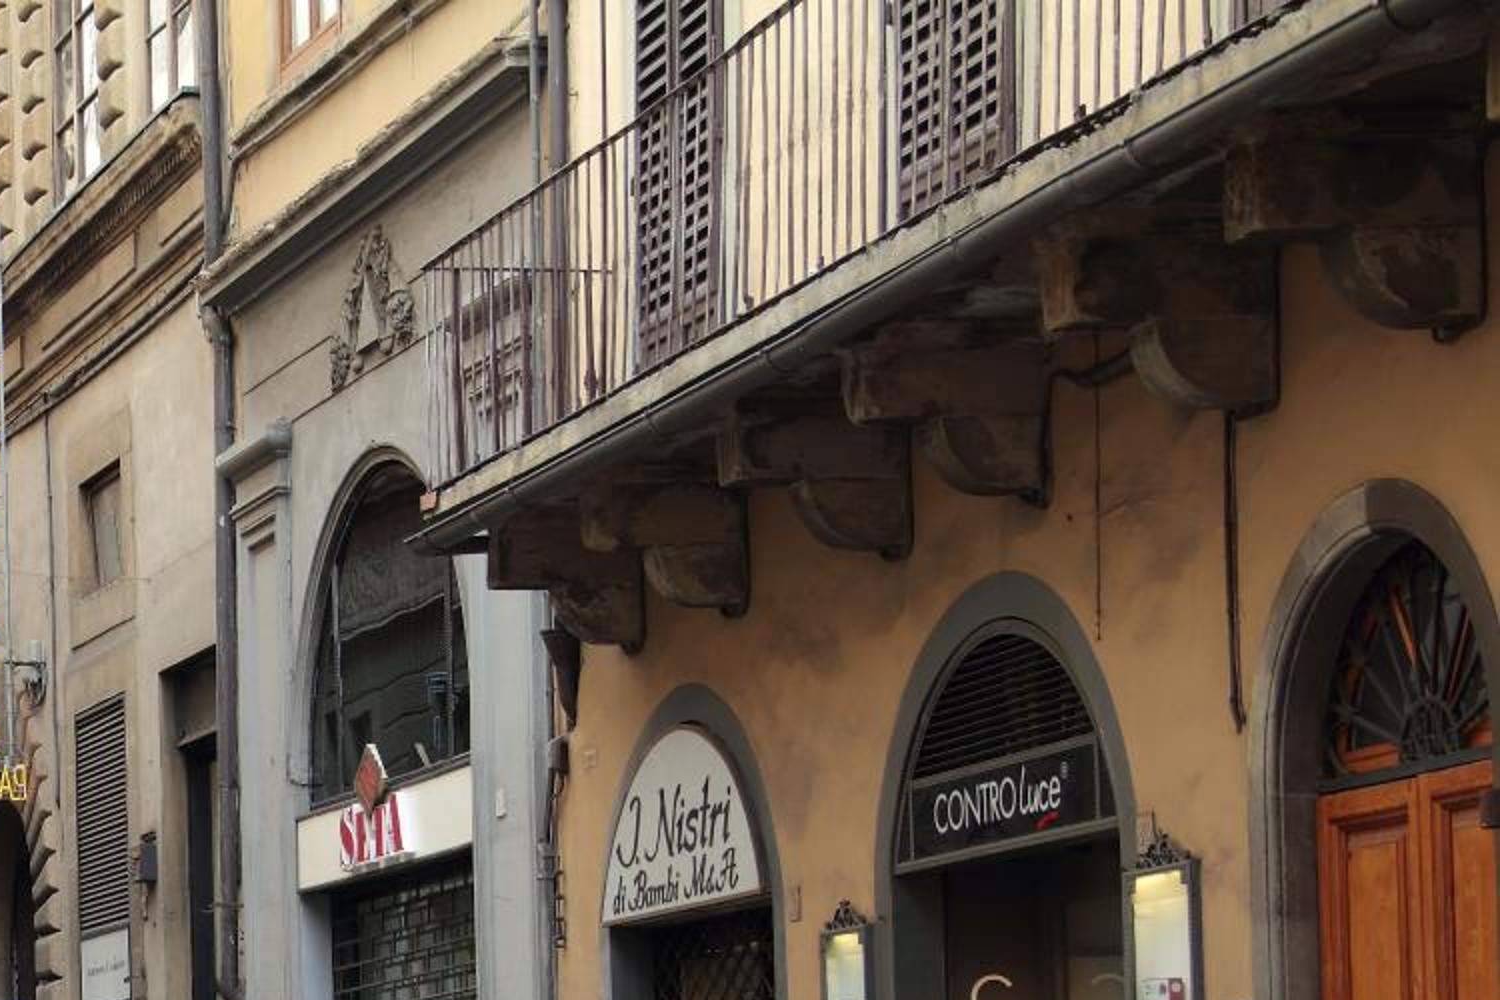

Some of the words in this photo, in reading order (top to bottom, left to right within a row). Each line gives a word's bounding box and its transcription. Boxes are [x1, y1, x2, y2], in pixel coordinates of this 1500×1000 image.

[644, 775, 731, 863] Nistri
[613, 875, 627, 915] di
[627, 864, 681, 912] Bambi
